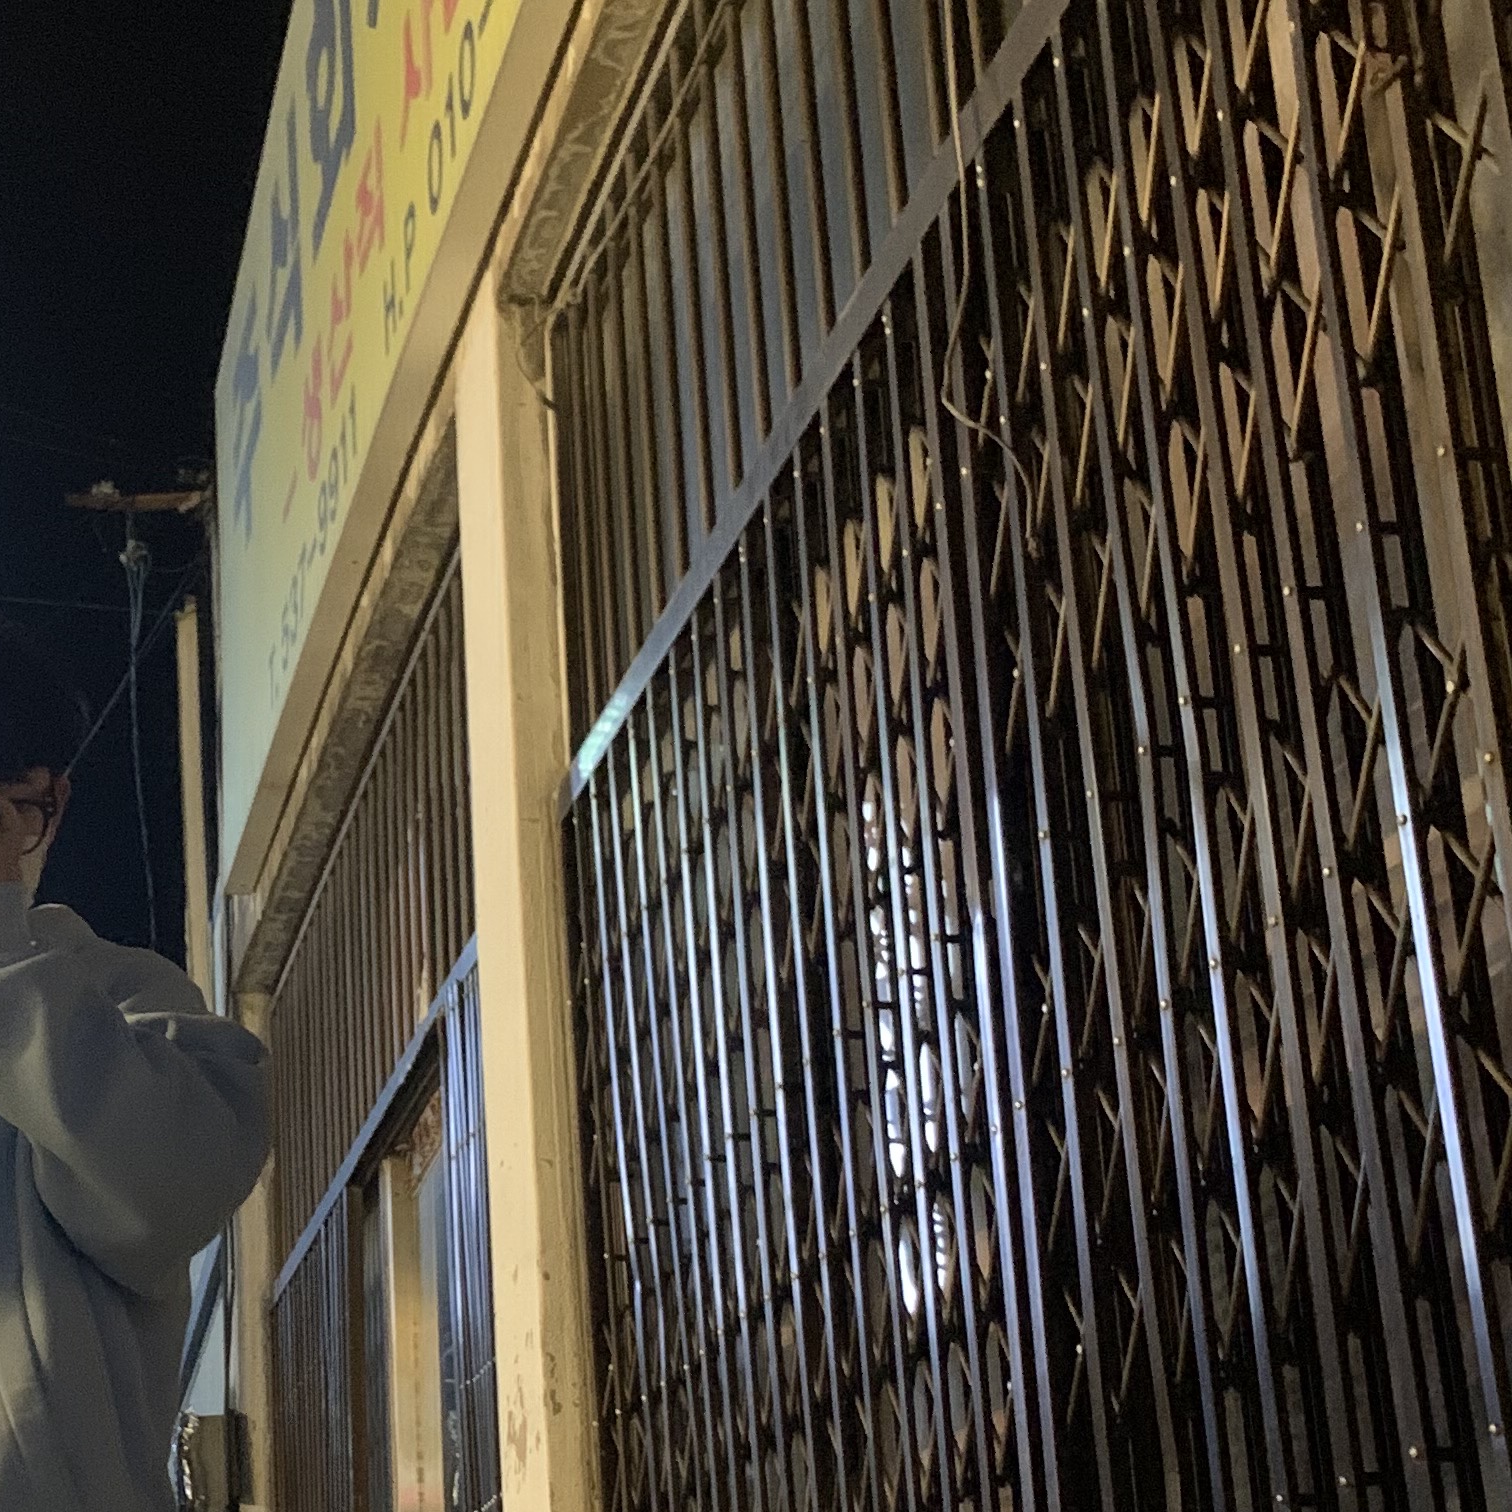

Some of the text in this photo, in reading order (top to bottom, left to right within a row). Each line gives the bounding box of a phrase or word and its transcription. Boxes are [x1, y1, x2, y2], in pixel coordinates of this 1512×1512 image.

[232, 0, 380, 548] 주식회
[280, 383, 359, 676] 537-9911
[381, 200, 416, 357] H.P
